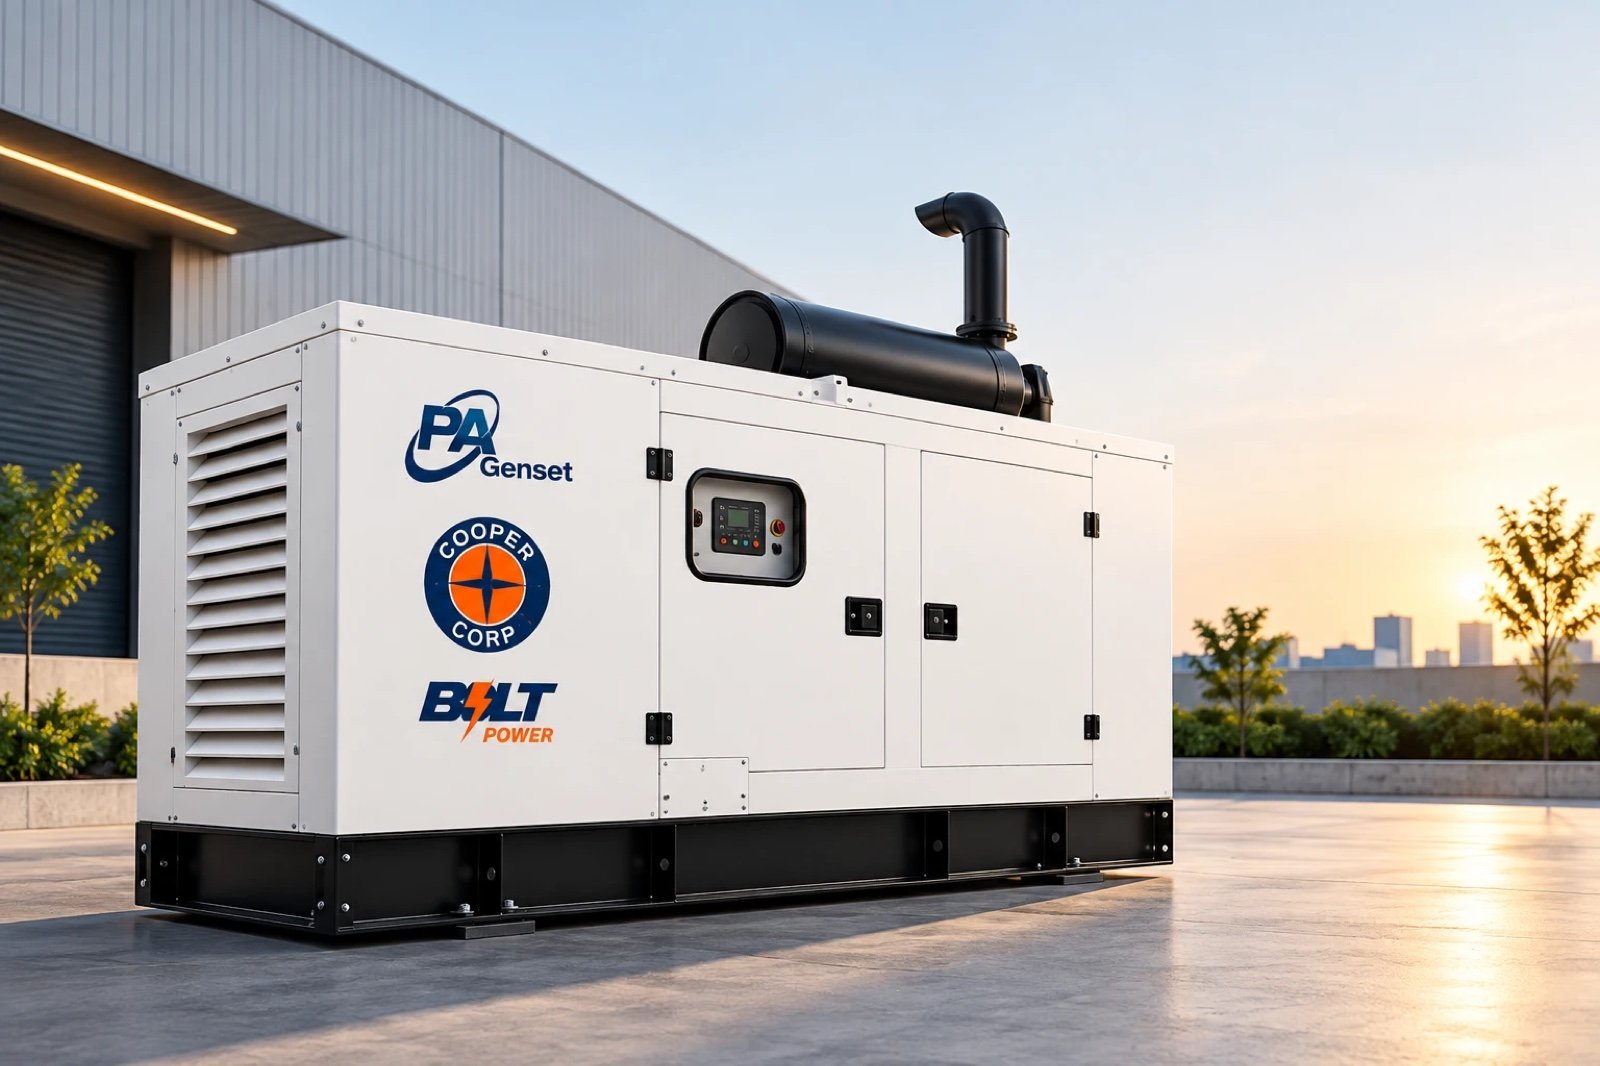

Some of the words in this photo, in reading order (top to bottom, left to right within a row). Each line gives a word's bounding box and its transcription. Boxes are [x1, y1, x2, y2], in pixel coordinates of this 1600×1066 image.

[418, 404, 497, 455] PA
[480, 456, 574, 482] Genset
[439, 522, 535, 562] COOPER
[451, 620, 516, 648] CORP
[482, 727, 554, 743] POWER
